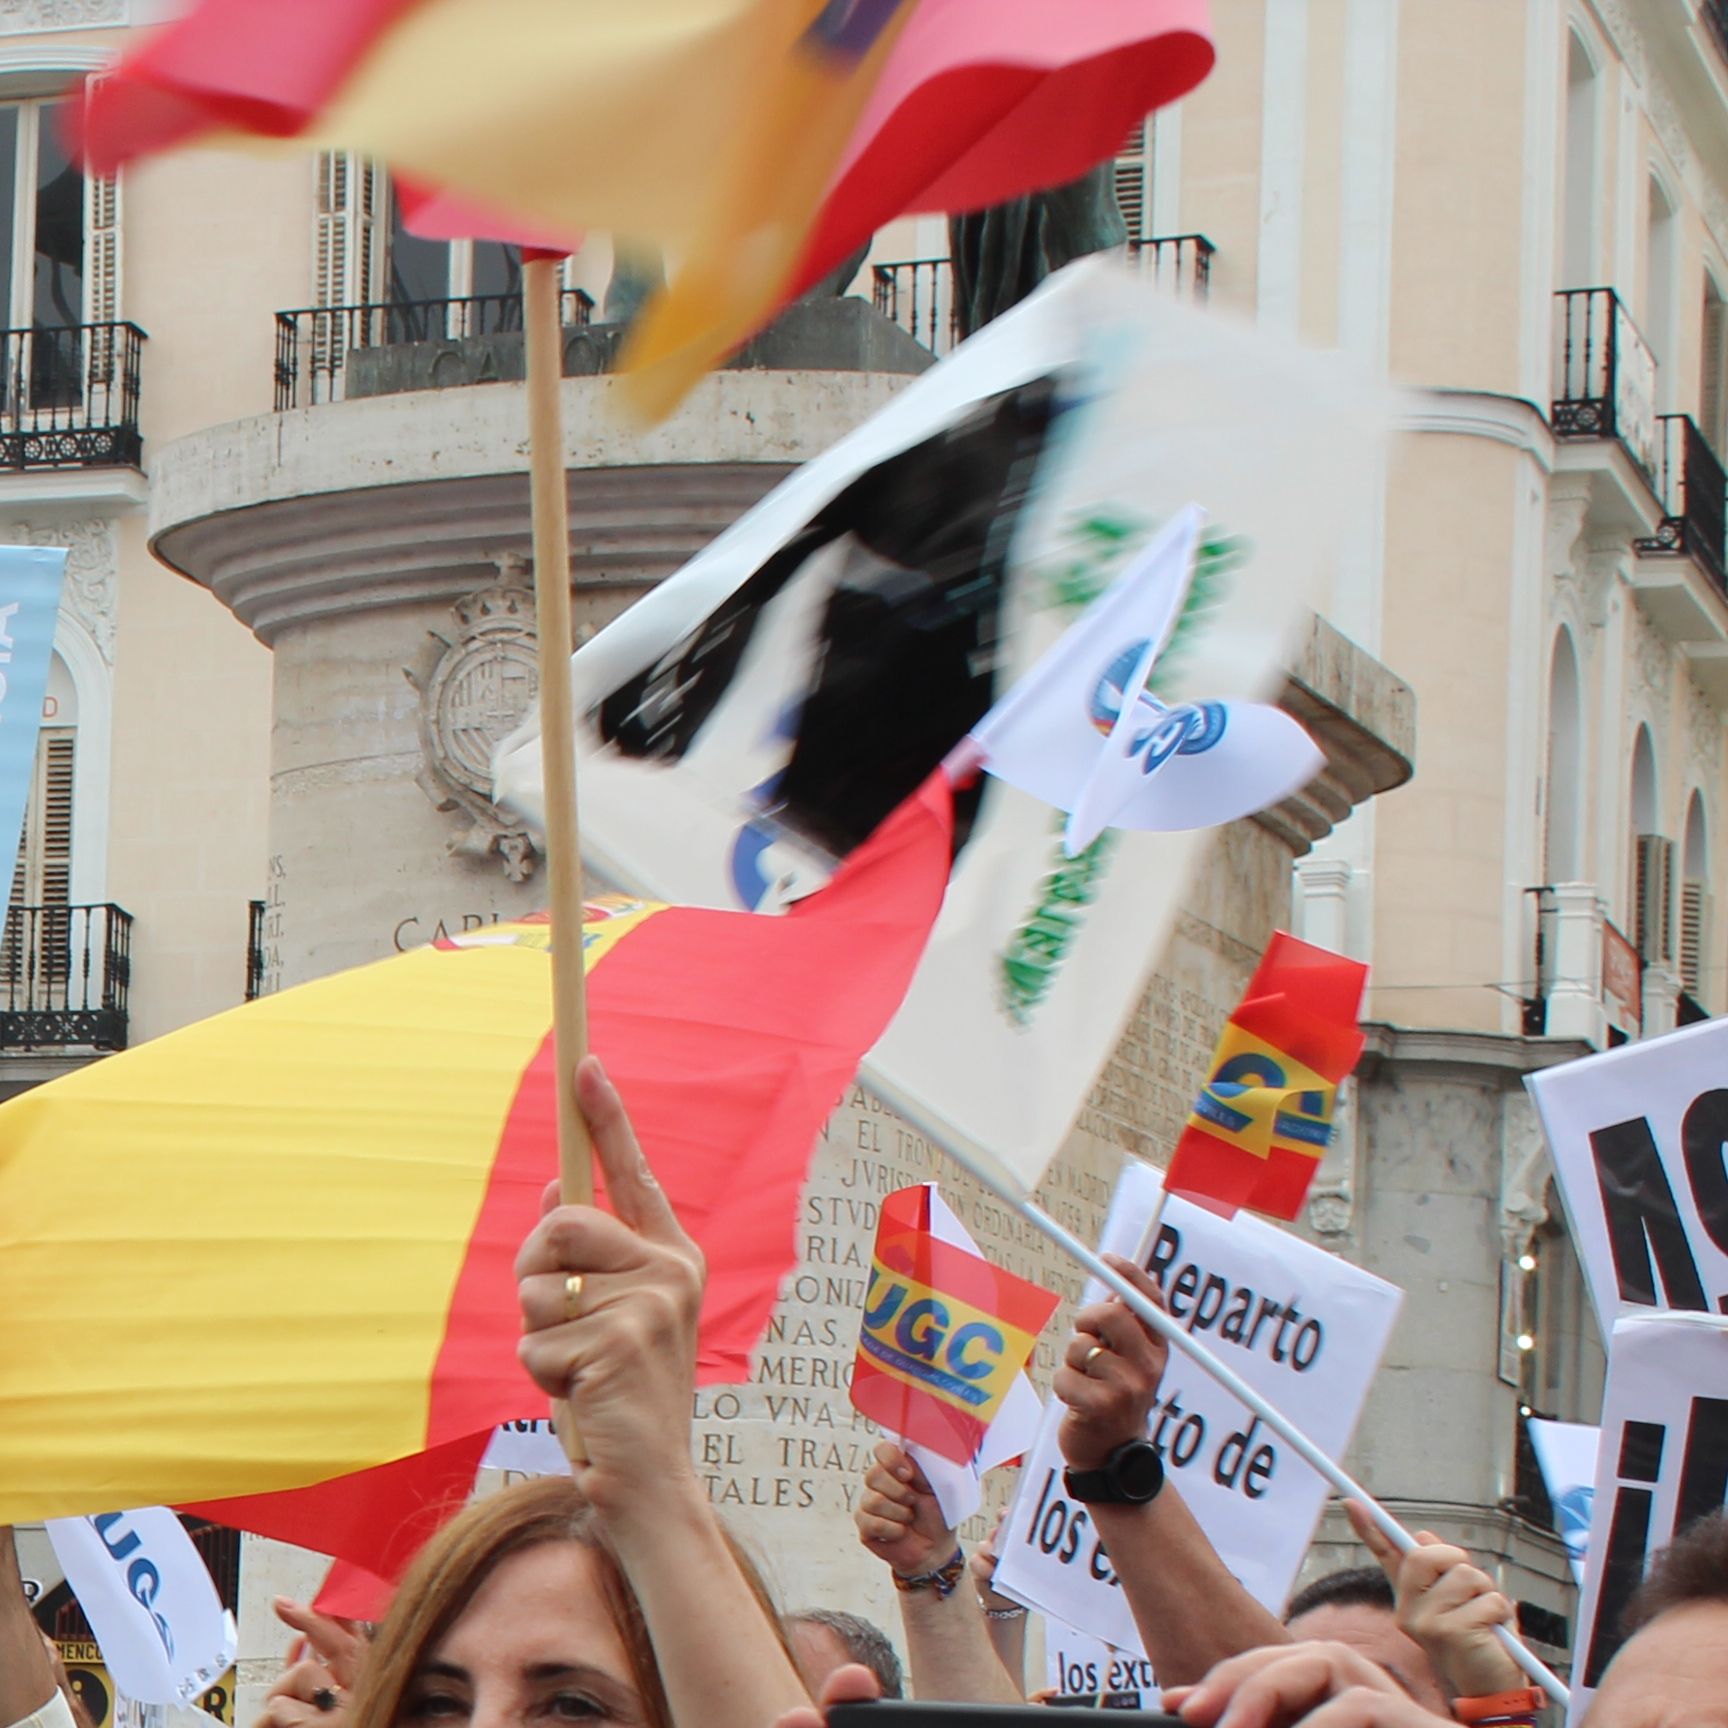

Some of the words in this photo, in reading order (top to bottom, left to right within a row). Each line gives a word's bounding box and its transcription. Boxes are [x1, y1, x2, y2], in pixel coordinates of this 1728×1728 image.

[807, 1196, 876, 1232] STVD
[1144, 1222, 1325, 1374] Reparto
[1212, 1413, 1276, 1499] de
[1024, 1467, 1087, 1565] los
[1058, 1651, 1098, 1695] los
